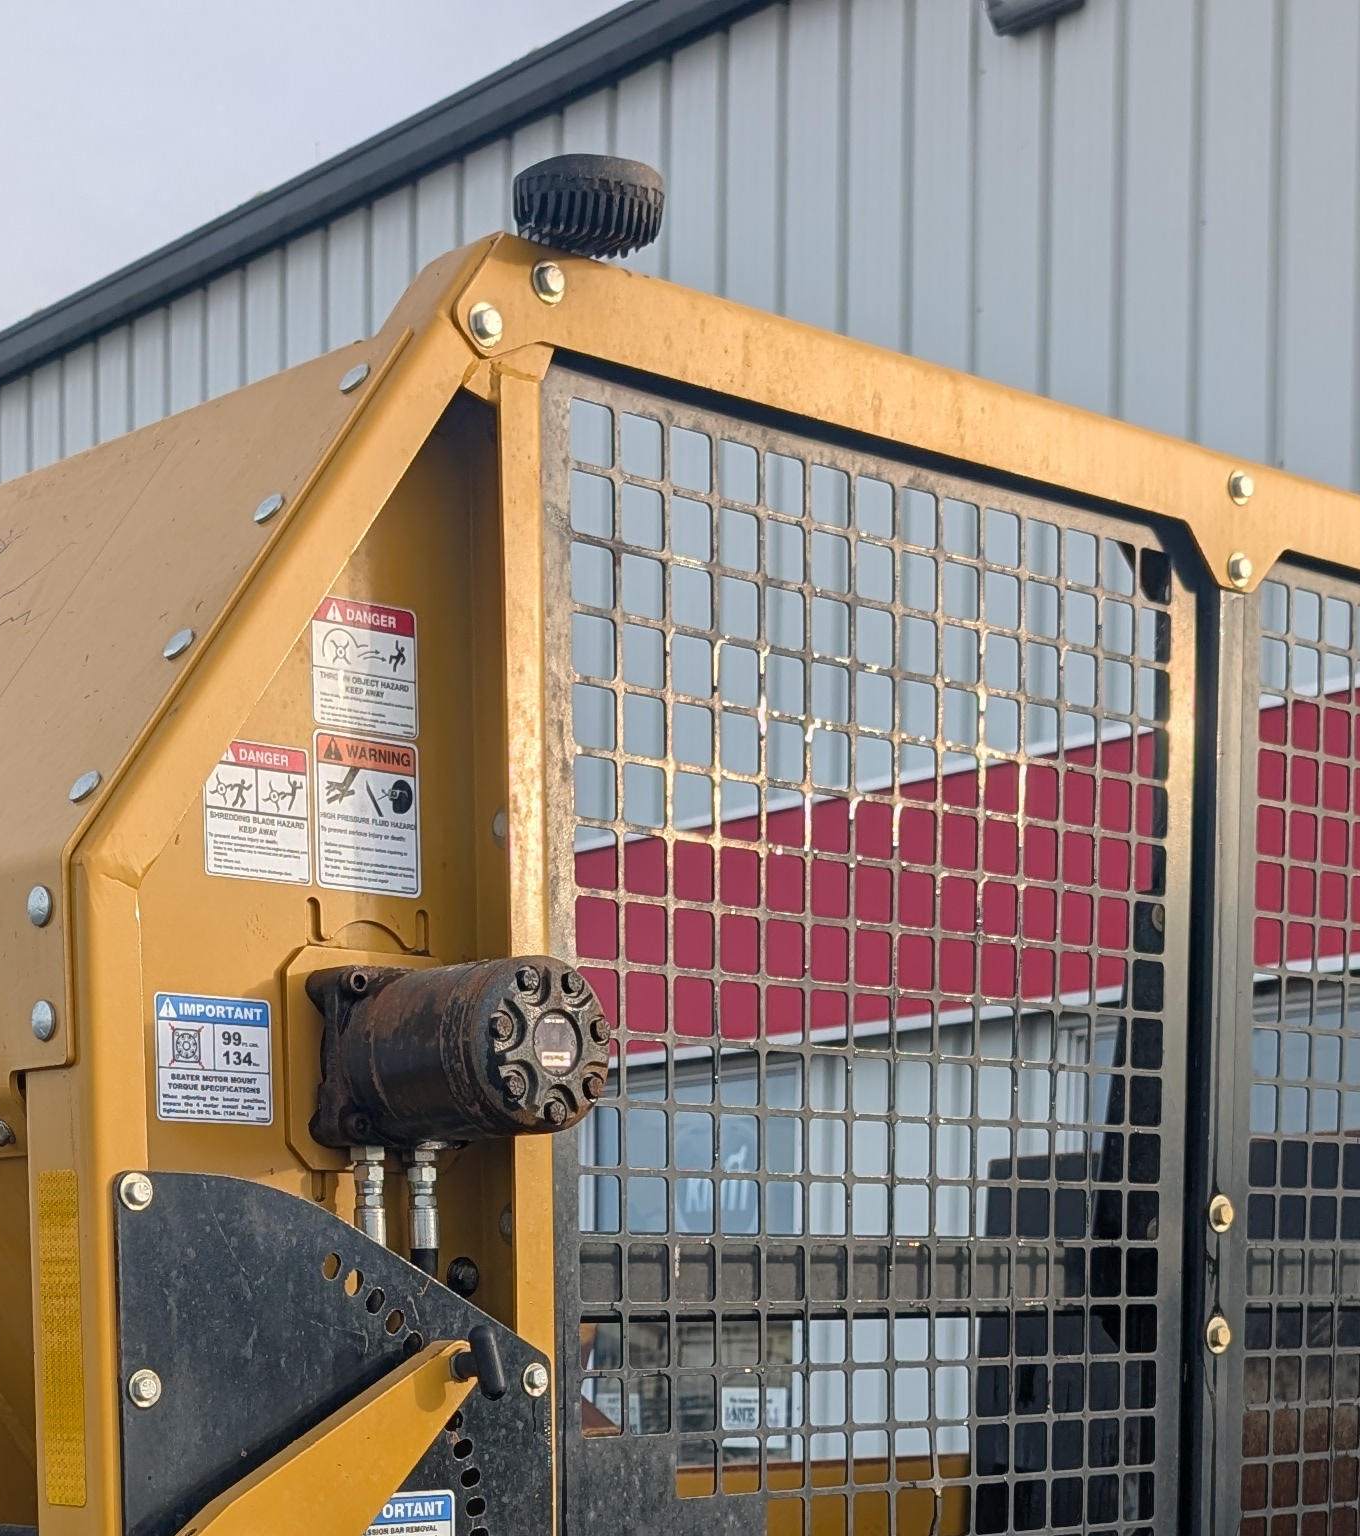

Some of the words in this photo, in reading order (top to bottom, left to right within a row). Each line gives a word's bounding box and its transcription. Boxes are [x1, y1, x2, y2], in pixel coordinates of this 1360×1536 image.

[346, 609, 397, 629] DANGER
[319, 670, 351, 683] THRON
[352, 676, 379, 688] OBJECT
[380, 681, 409, 693] HAZARD
[345, 686, 364, 696] KEEP
[365, 688, 385, 698] AWAY
[239, 748, 289, 767] DANGER
[346, 743, 411, 768] WARNING
[209, 811, 251, 823] SHREDDING
[253, 816, 275, 827] BLADE
[276, 819, 305, 830] HAZARD
[320, 811, 336, 821] HIGH
[337, 813, 370, 826] PRESSURE
[371, 818, 389, 828] FLUID
[390, 820, 416, 831] HAZARD
[238, 825, 257, 835] KEEP
[258, 827, 278, 837] AWAY
[178, 1002, 263, 1021] IMPORTANT
[221, 1031, 242, 1047] 99
[222, 1050, 253, 1067] 134
[167, 1082, 199, 1091] TORQUE
[200, 1084, 261, 1094] SPECIFICATIONS
[170, 1072, 200, 1081] BEATER
[202, 1074, 229, 1083] MOTOR
[230, 1076, 257, 1085] MOUNT
[382, 1500, 445, 1519] ORTANT
[390, 1526, 405, 1535] BAR
[405, 1524, 438, 1534] REMOVAL
